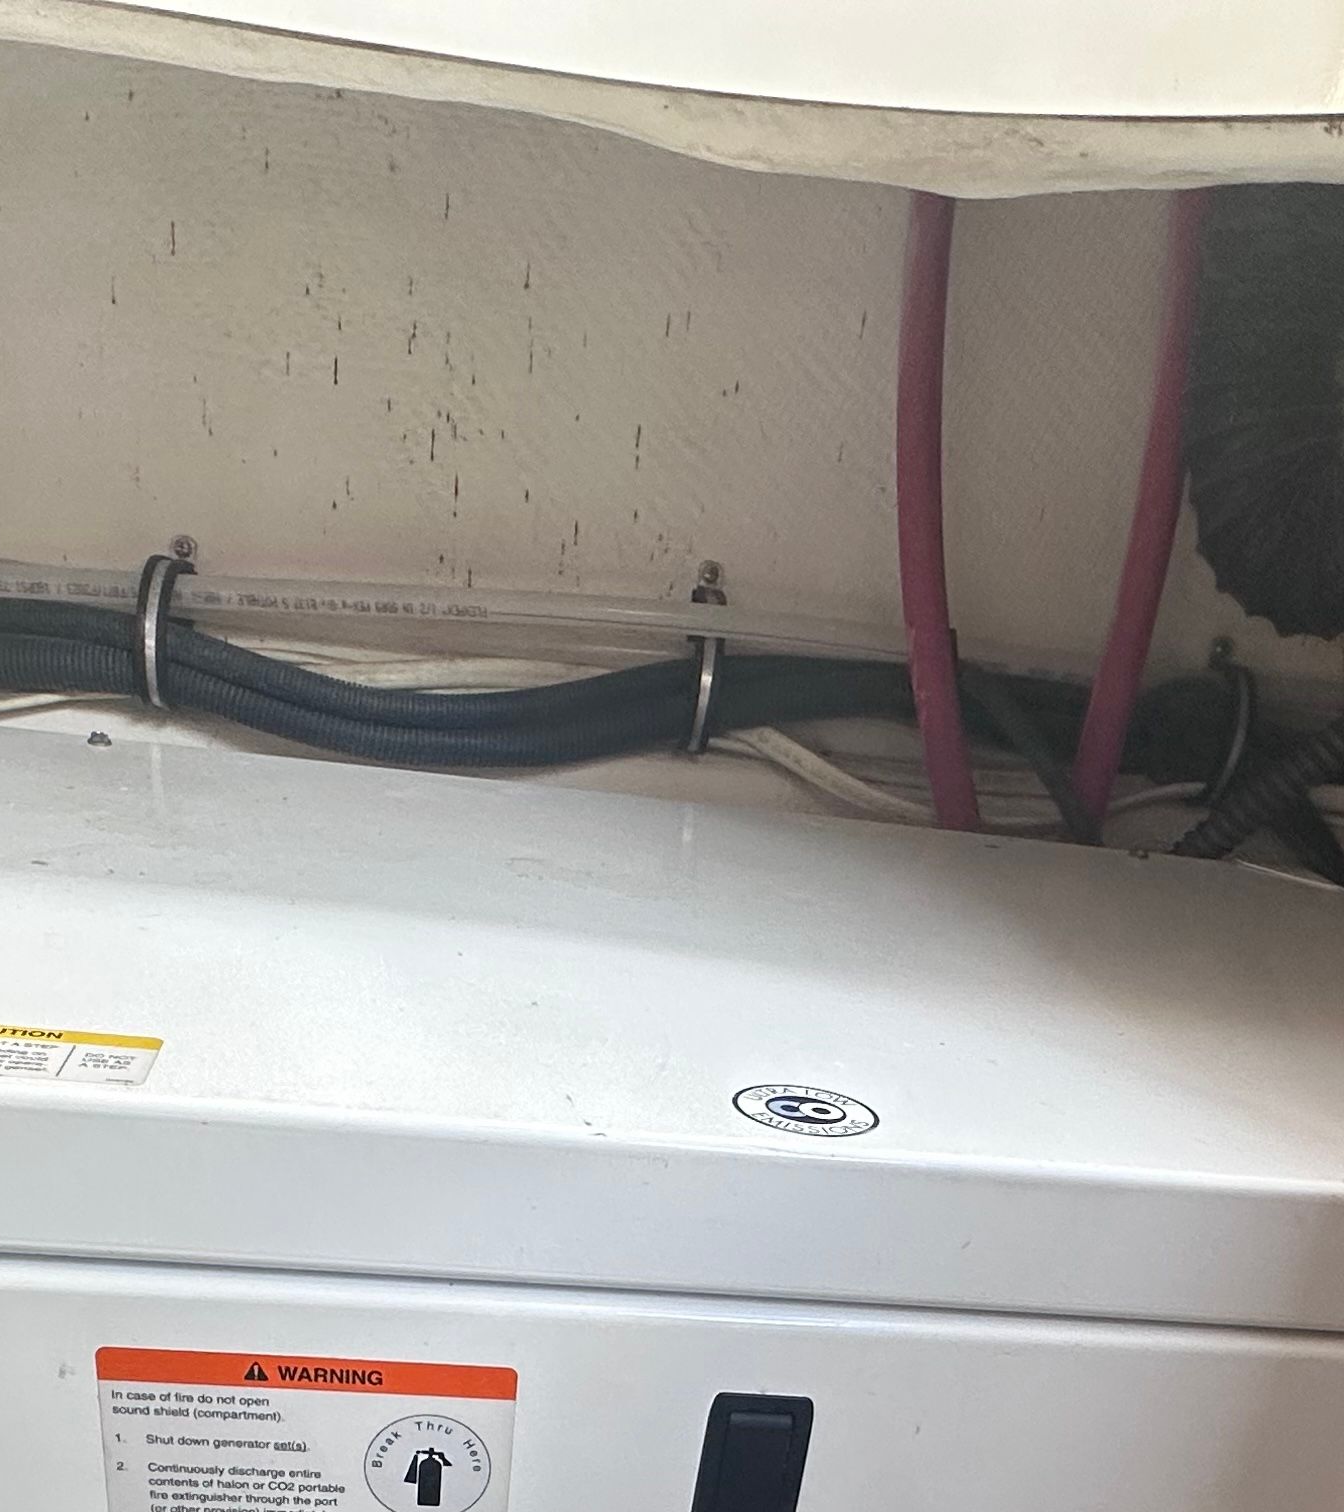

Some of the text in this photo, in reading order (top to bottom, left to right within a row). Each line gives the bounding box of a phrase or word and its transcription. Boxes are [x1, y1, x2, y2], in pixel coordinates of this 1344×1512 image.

[278, 1366, 383, 1386] WARNING
[111, 1389, 270, 1407] In case of fire do not open
[112, 1405, 150, 1415] sound
[154, 1407, 190, 1417] shield
[146, 1434, 174, 1446] Shut
[177, 1436, 210, 1447] down
[213, 1438, 269, 1450] generator
[371, 1421, 481, 1472] Break Thru Here
[147, 1462, 226, 1477] Continuously
[228, 1466, 286, 1480] discharge
[289, 1469, 321, 1479] entire
[148, 1477, 345, 1494] contents of halon or CO2 portable
[149, 1490, 338, 1508] fire extinguisher through the port
